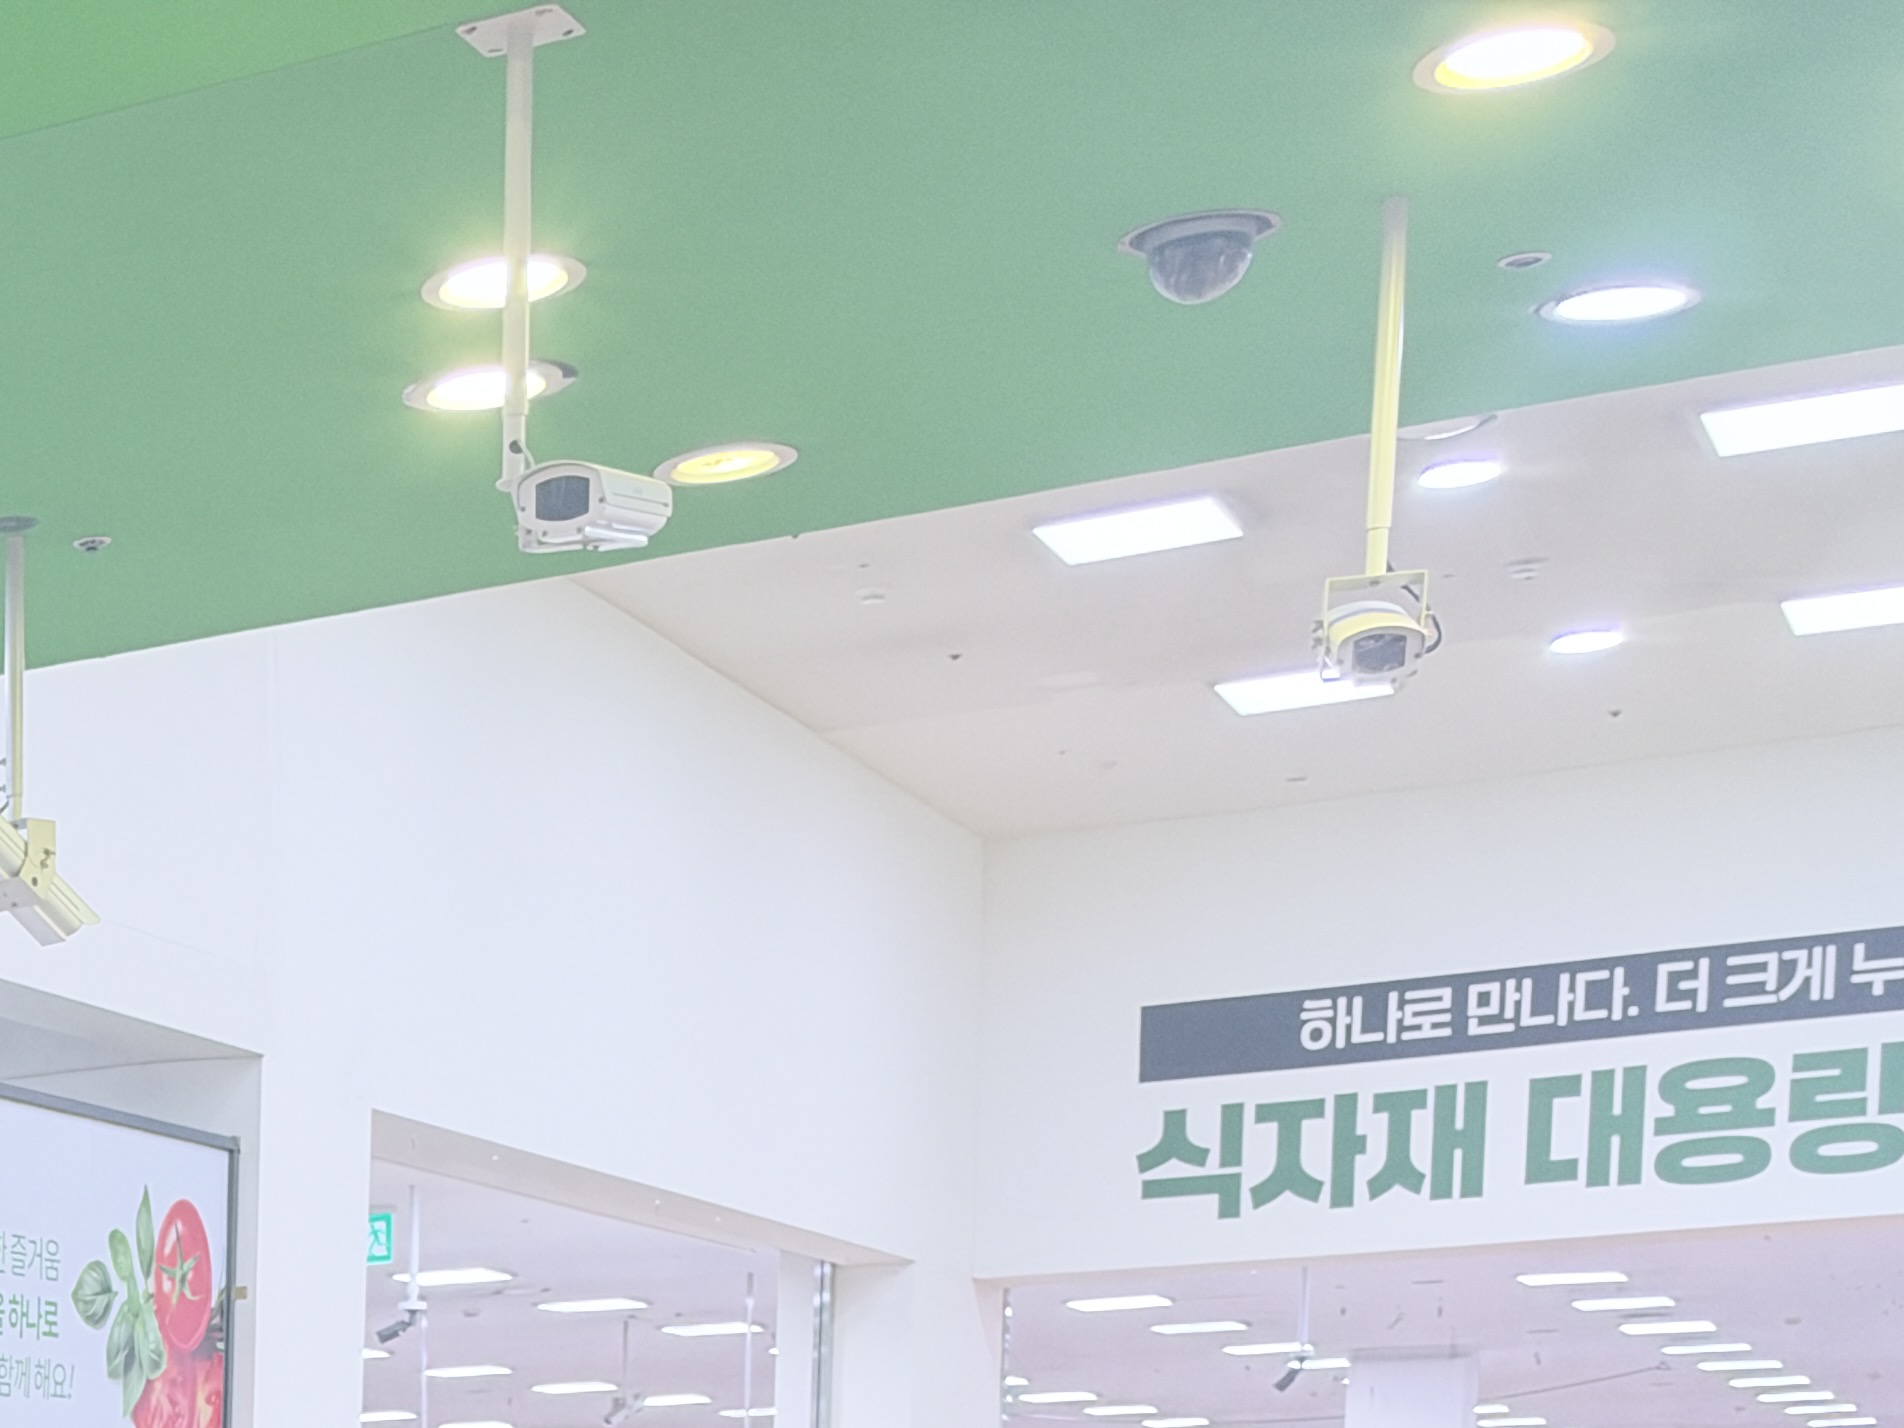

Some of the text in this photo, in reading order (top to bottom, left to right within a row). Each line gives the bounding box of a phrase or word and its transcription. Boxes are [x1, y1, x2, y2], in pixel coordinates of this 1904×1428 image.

[1299, 987, 1452, 1053] 하나로
[1464, 966, 1640, 1036] 만나다.
[1654, 958, 1710, 1015] 더
[1722, 944, 1837, 1010] 크게
[1135, 1079, 1489, 1220] 식자재
[8, 1232, 62, 1284] 즐거움
[7, 1291, 60, 1341] 하나로
[32, 1357, 76, 1402] 해요!
